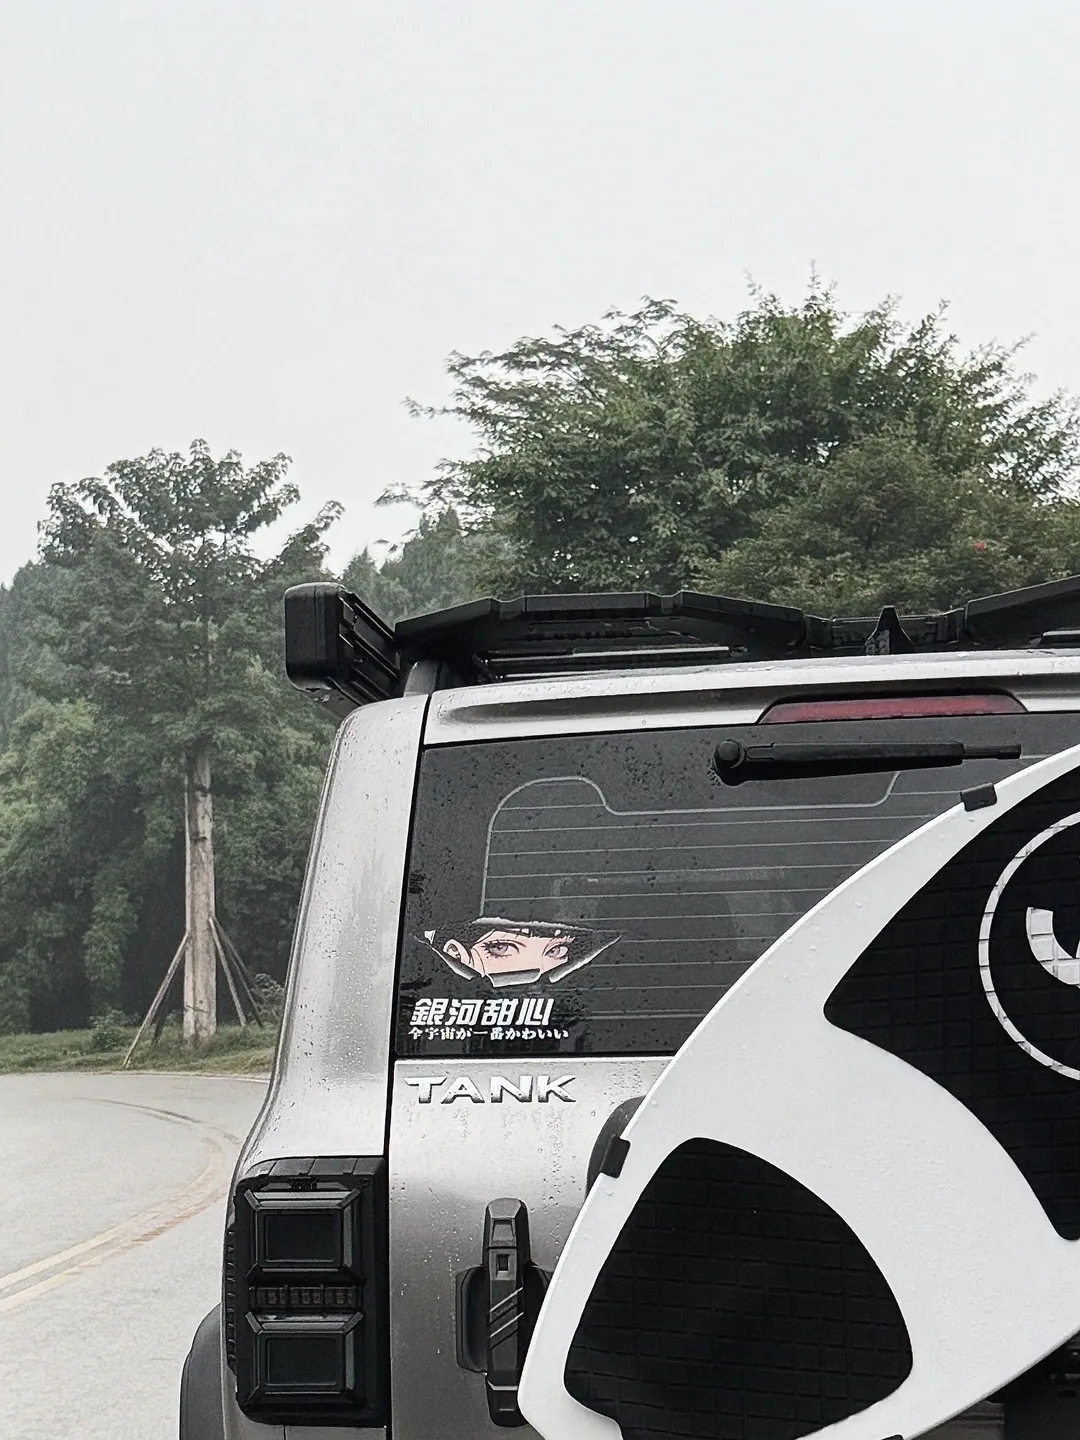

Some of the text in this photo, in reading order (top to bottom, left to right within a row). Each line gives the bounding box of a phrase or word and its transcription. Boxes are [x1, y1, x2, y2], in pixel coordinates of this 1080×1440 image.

[410, 998, 554, 1026] 銀河甜心
[405, 1075, 576, 1104] TANK
